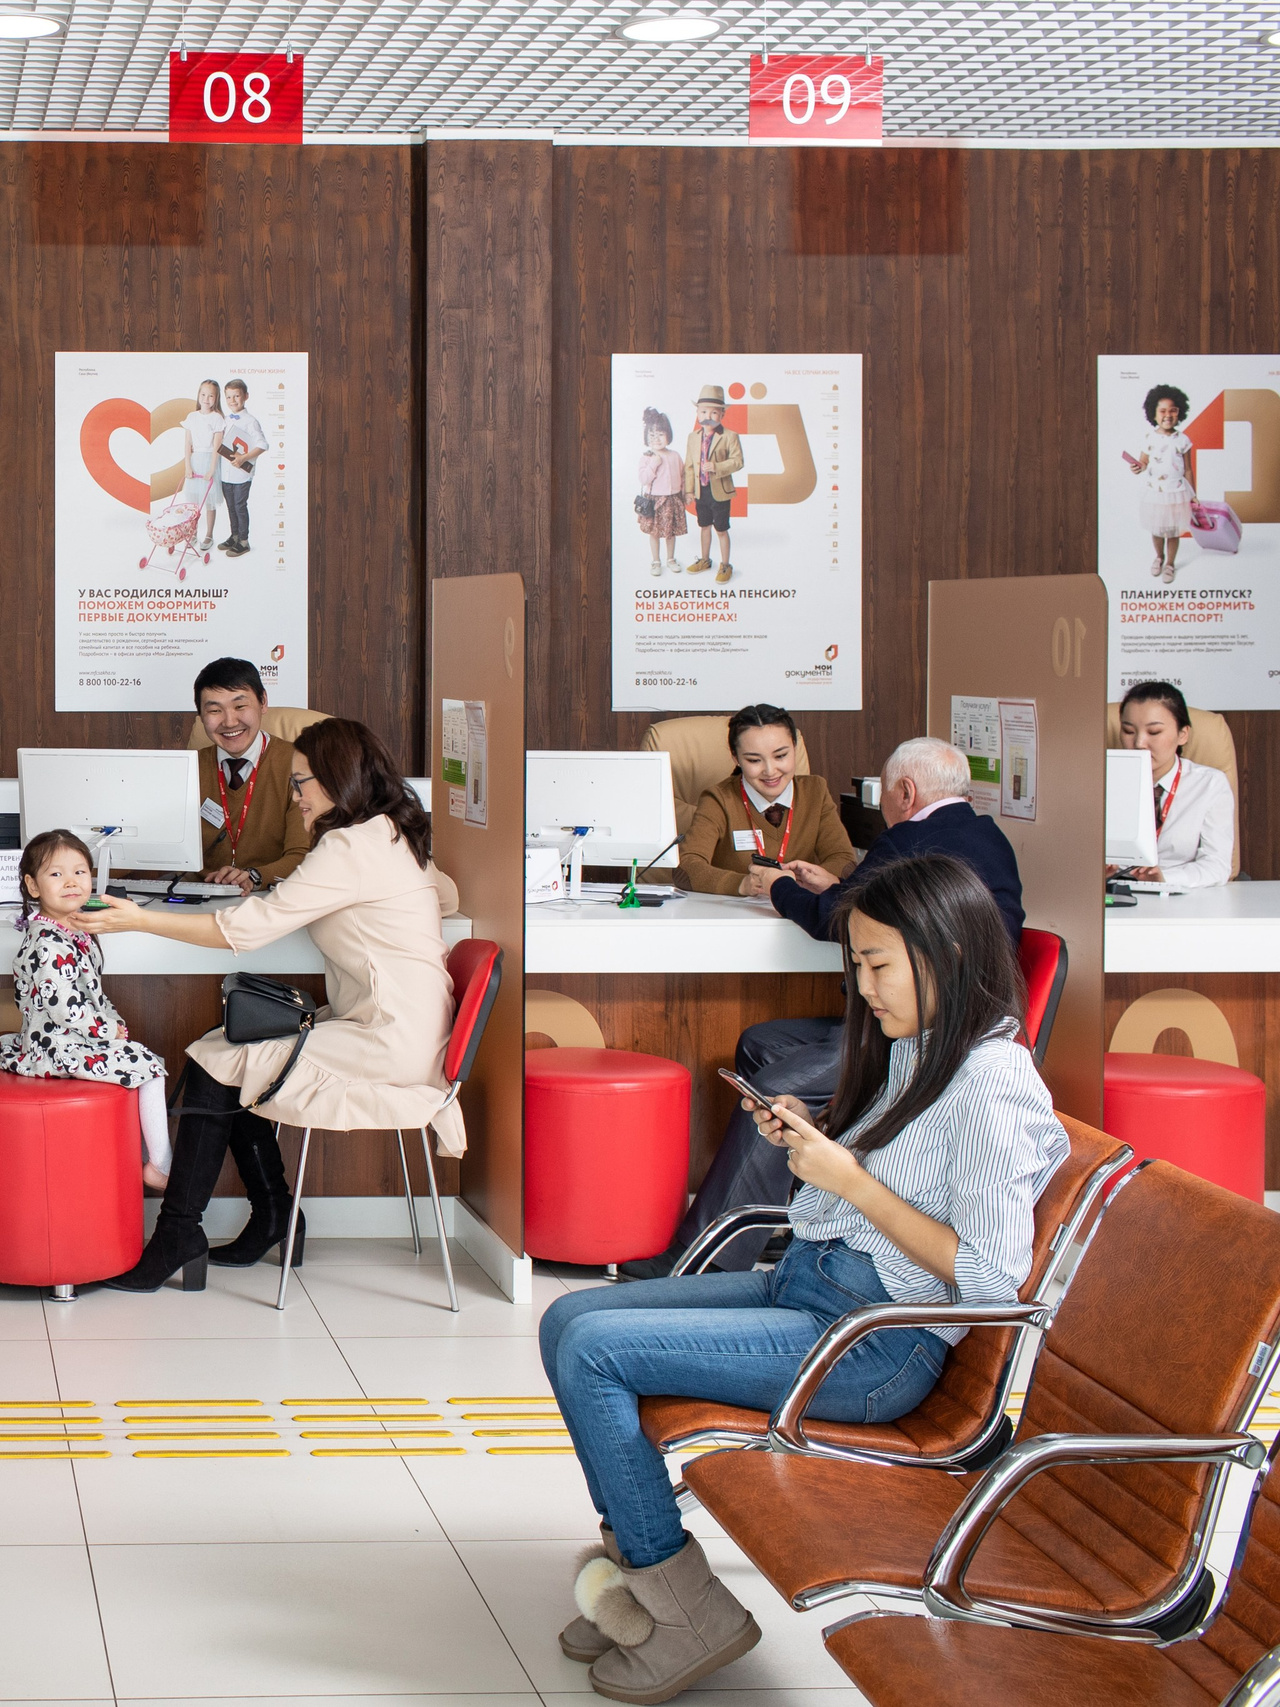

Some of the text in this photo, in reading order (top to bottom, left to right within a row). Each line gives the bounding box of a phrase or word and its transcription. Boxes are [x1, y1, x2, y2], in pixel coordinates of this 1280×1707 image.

[204, 72, 270, 123] 08
[782, 73, 852, 125] 09
[78, 589, 228, 599] У ВАС РОДИЛСЯ МАЛЫШ?
[635, 590, 796, 598] СОБИРАЕТЕСЬ НА ПЕНСИЮ?
[1121, 590, 1252, 599] ПЛАНИРУЕТЕ ОТПУСК?
[79, 601, 216, 610] ПОМОЖЕМ ОФОРМИТЬ
[636, 601, 729, 610] МЫ ЗАБОТИМСЯ
[1121, 601, 1255, 611] ПОМОЖЕМ ОФОРМИТЬ
[79, 613, 207, 623] ПЕРВЫЕ ДОКУМЕНТЫ!
[635, 613, 737, 622] О ПЕНСИОНЕРАХ!
[1121, 613, 1223, 623] ЗАГРАНПАСПОРТ!
